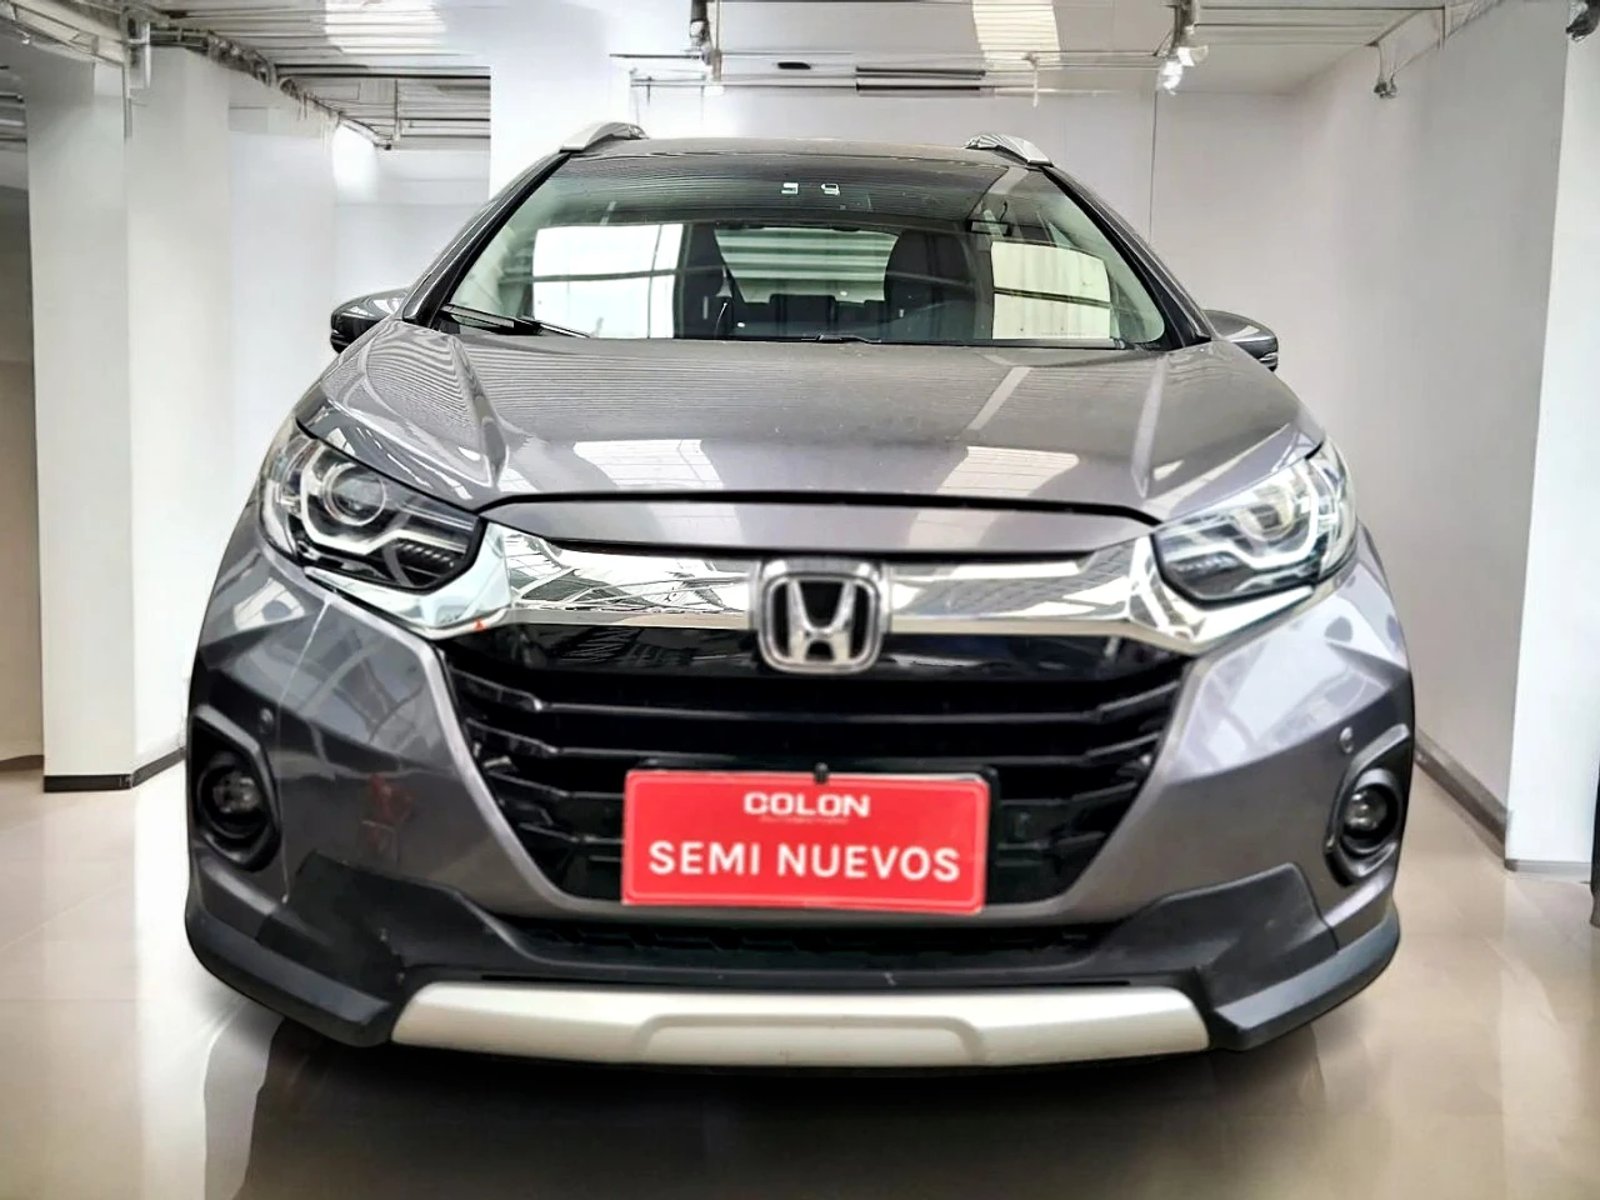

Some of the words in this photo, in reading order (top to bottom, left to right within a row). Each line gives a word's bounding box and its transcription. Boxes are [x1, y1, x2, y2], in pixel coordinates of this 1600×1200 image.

[743, 791, 871, 818] COLON
[648, 841, 761, 876] SEMI
[776, 844, 961, 882] NUEVOS
